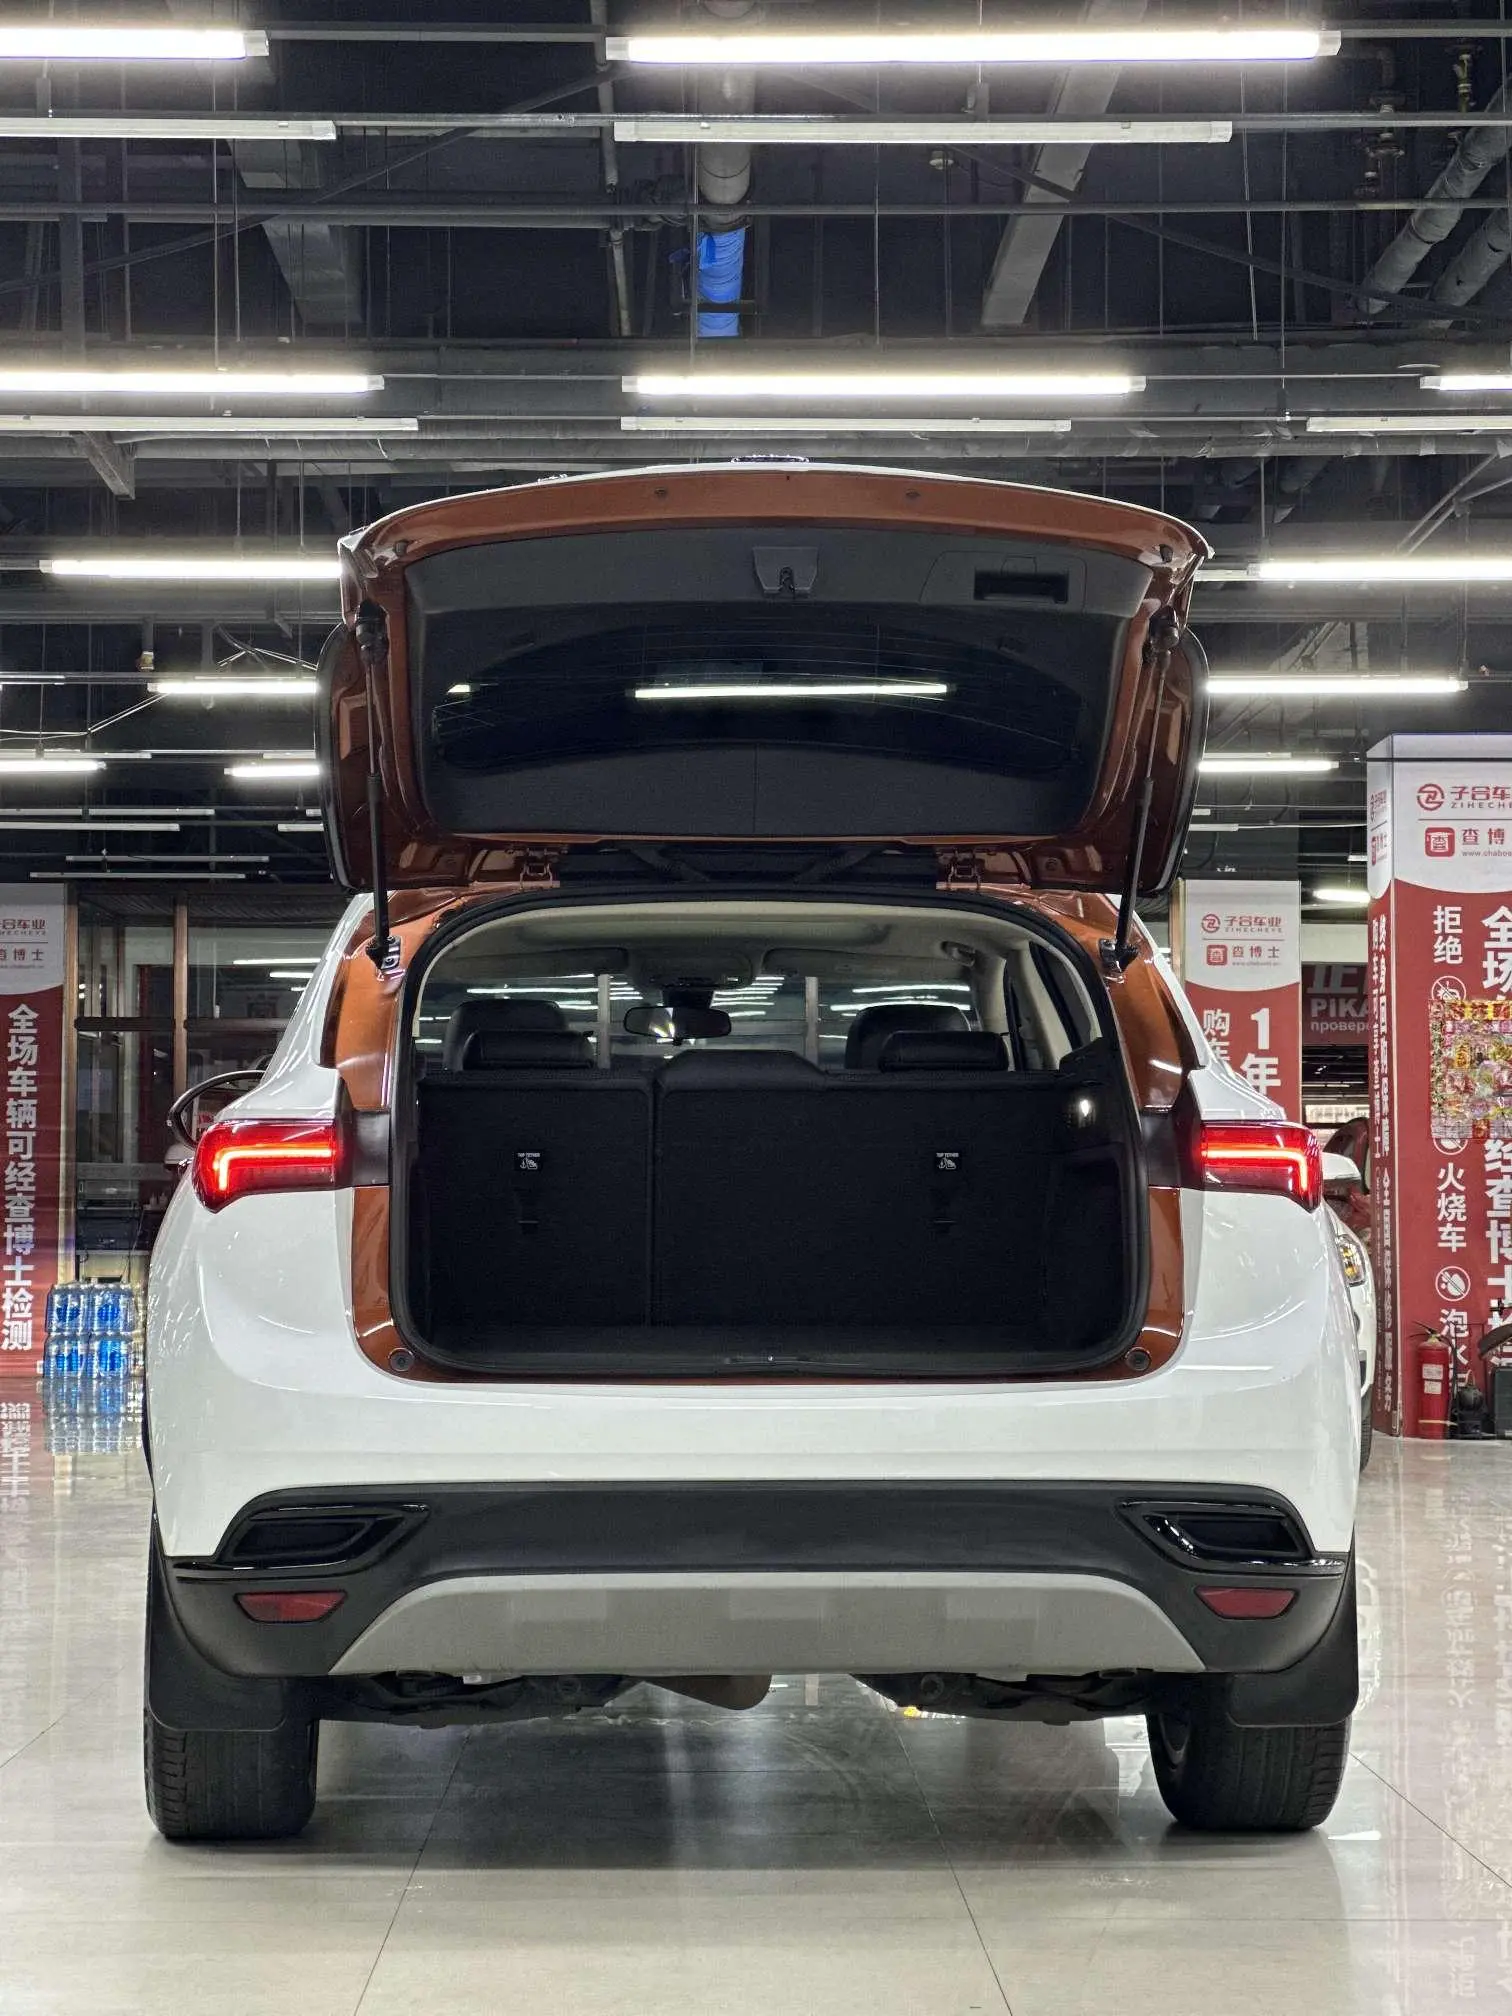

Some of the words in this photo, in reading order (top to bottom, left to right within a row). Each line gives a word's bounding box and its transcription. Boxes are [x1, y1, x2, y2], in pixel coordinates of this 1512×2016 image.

[0, 918, 46, 930] 合车业
[1232, 945, 1280, 958] 查博士
[1432, 905, 1463, 964] 拒绝
[1, 1003, 39, 1351] 全场车辆可经查博士检测
[1437, 1162, 1467, 1252] 火烧车
